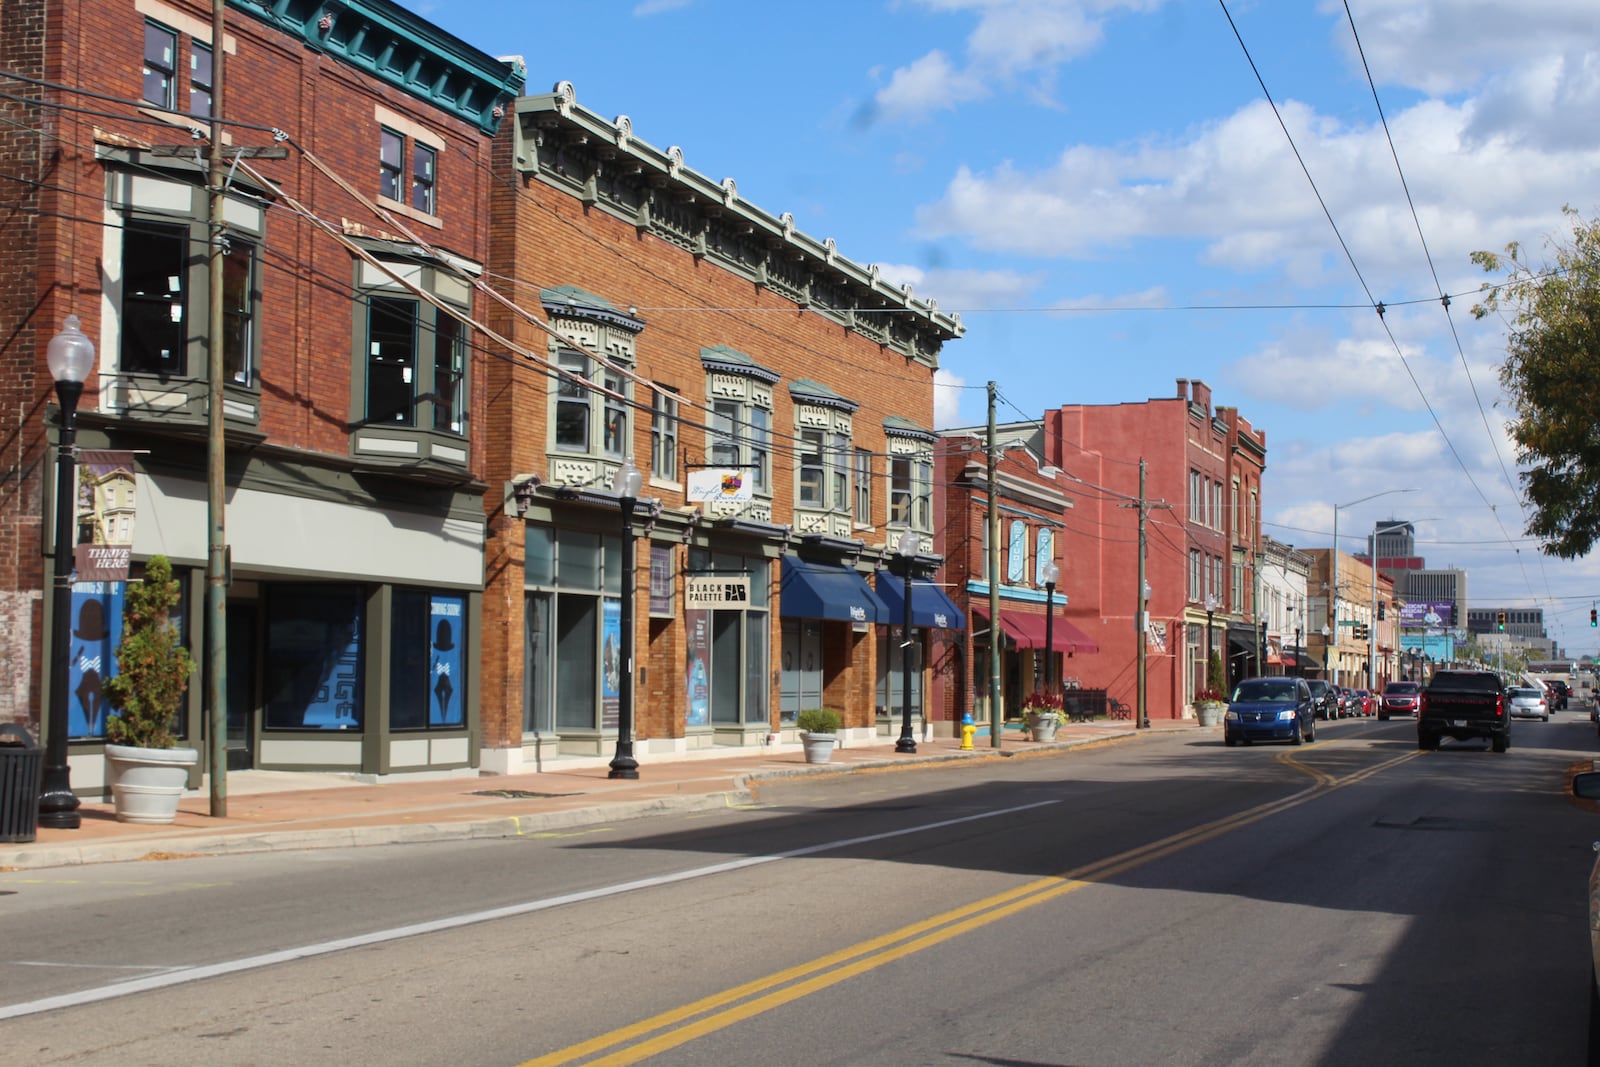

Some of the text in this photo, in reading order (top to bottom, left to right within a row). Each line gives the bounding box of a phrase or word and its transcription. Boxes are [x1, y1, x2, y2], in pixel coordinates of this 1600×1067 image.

[88, 549, 130, 559] THRIVE
[71, 582, 96, 593] OMING
[689, 584, 722, 592] BLACK
[689, 593, 722, 601] PALETTE
